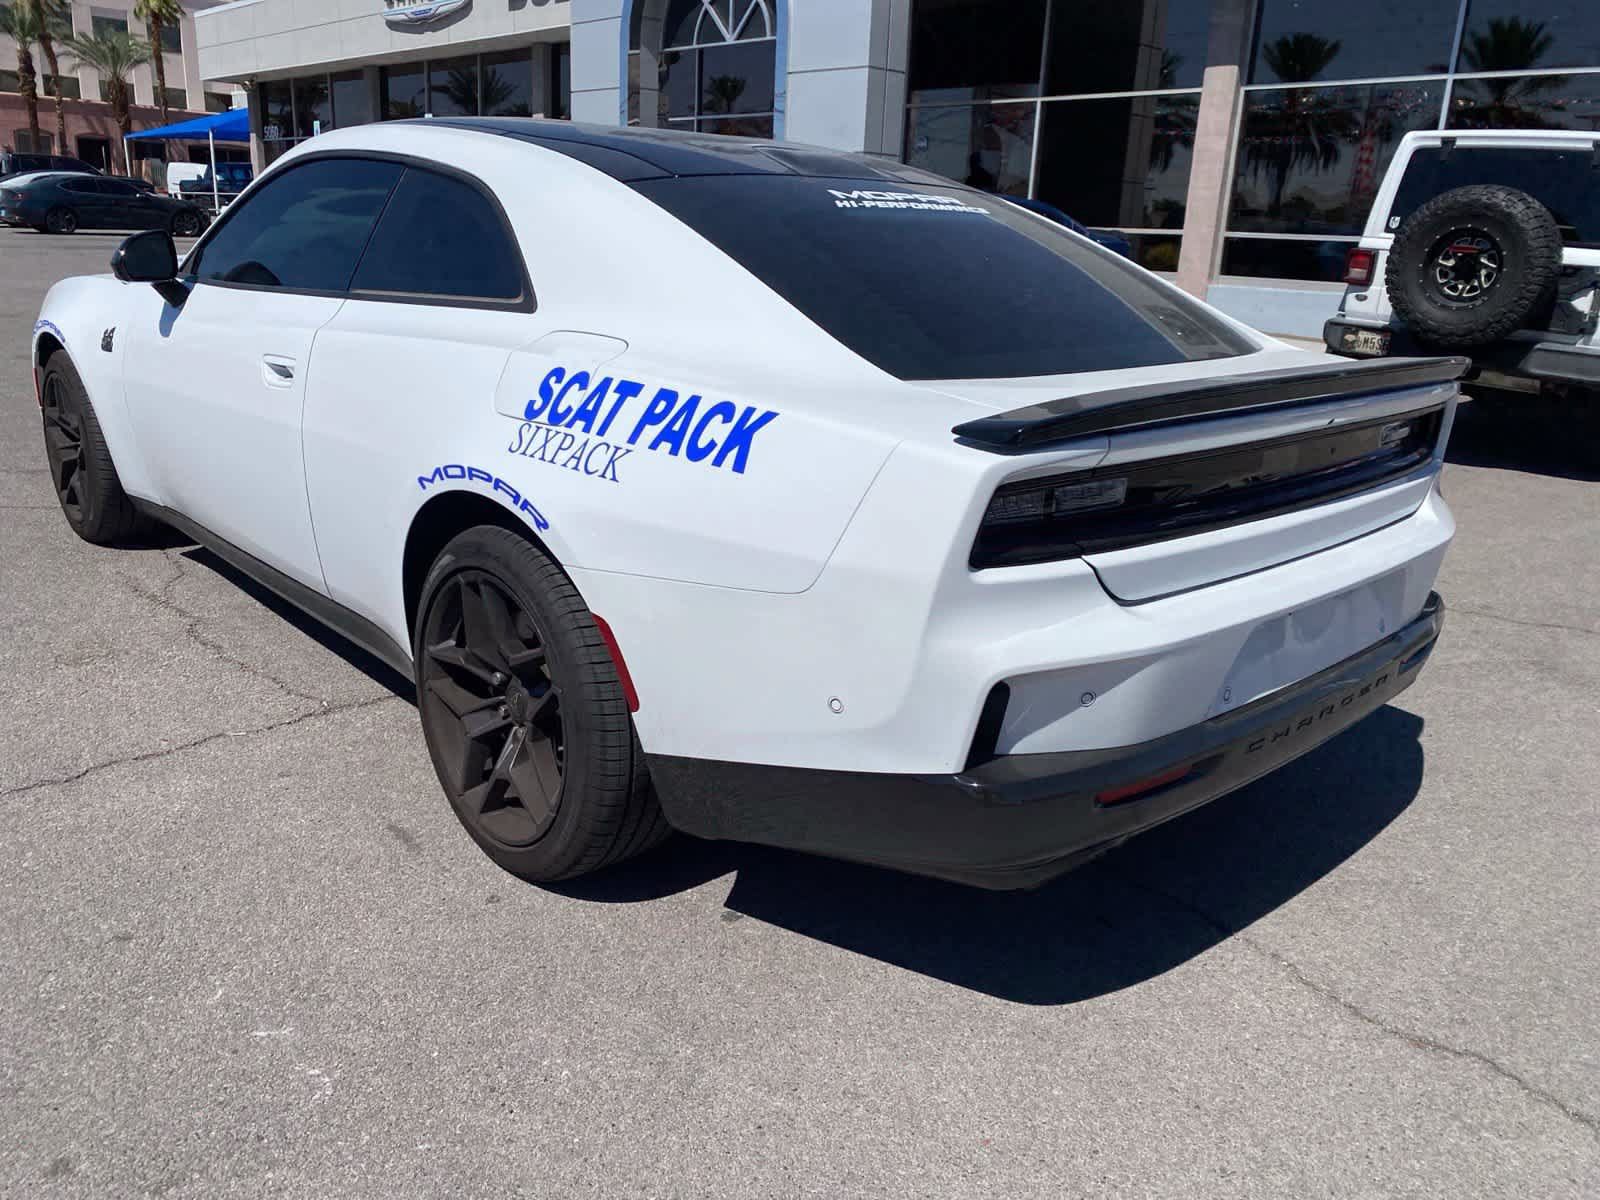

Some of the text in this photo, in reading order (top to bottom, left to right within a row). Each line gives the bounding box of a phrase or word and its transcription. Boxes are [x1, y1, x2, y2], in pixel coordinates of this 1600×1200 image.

[826, 189, 967, 206] MOPAR
[834, 200, 991, 214] HI-PERFORMANCE
[524, 366, 780, 475] SCAT PACK
[508, 421, 634, 483] SIXPACK
[417, 463, 550, 533] MOPAR
